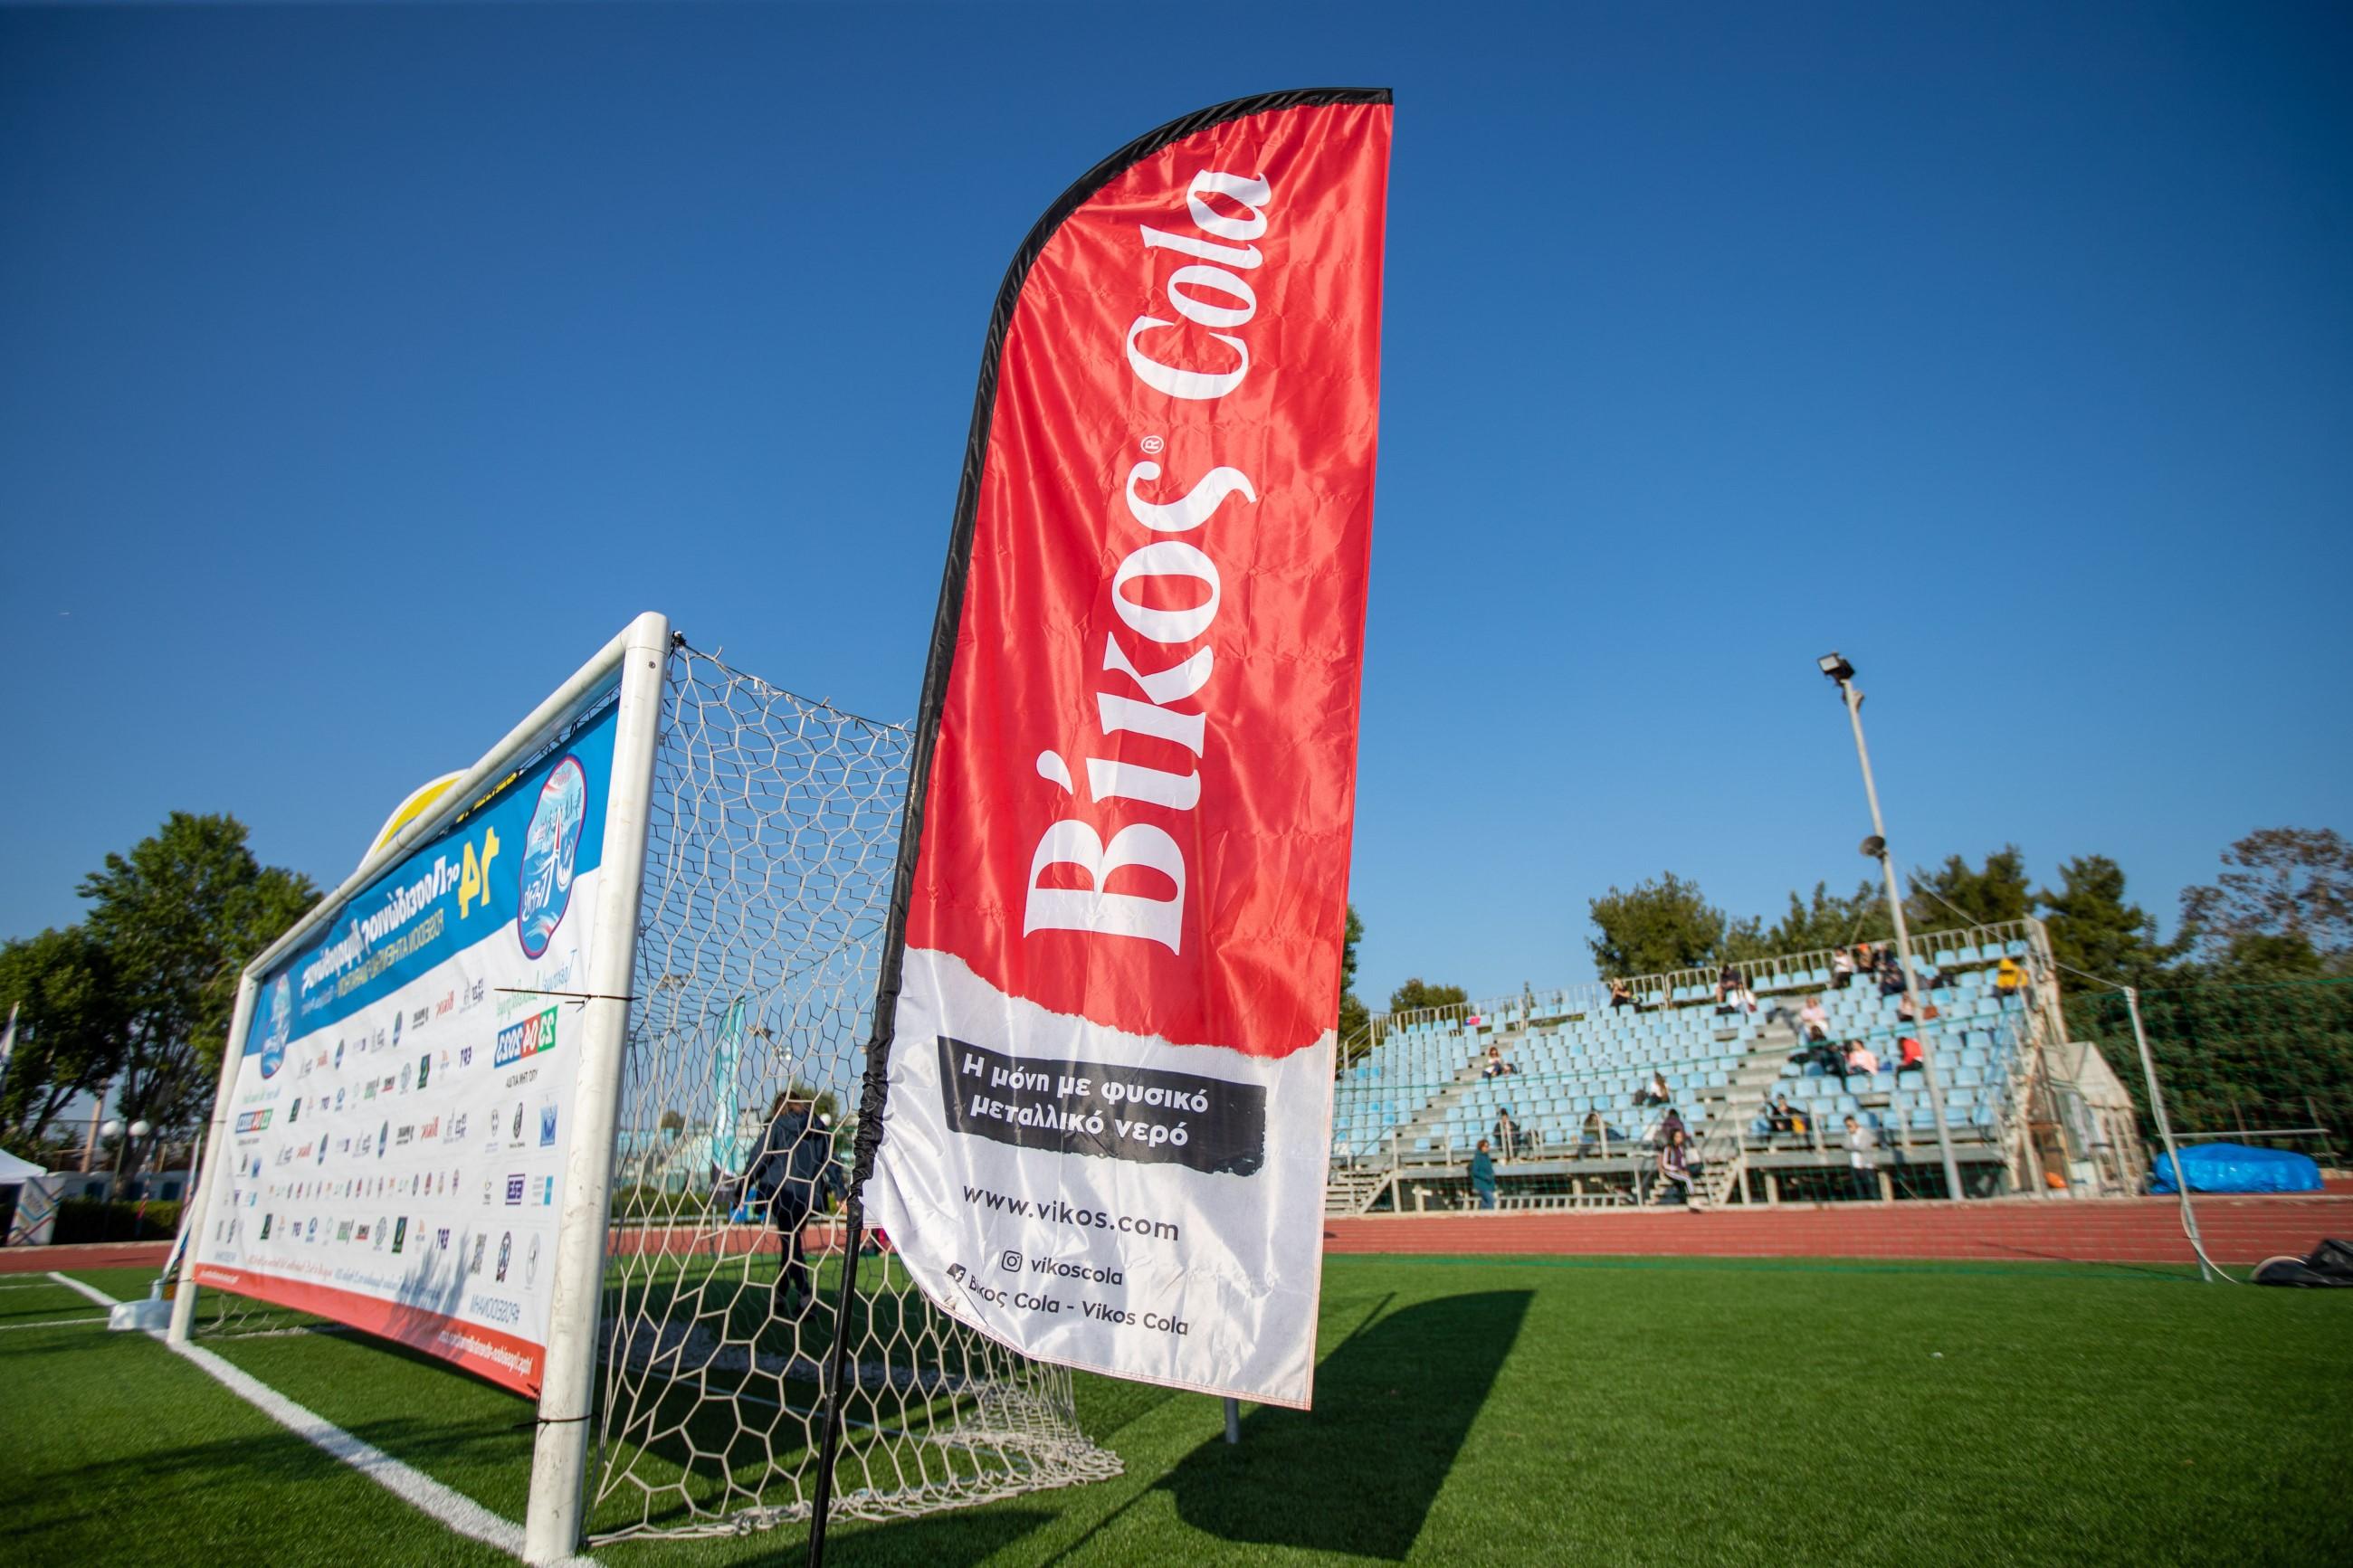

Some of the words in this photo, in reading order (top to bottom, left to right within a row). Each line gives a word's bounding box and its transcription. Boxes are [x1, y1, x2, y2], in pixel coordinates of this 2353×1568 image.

[1126, 168, 1272, 400] Cola
[962, 1052, 984, 1078] Η
[991, 1064, 1050, 1095] μόνη
[1057, 1074, 1091, 1099] με
[1100, 1080, 1209, 1114] φυσικό
[969, 1094, 1104, 1136] μεταλλικό
[1115, 1118, 1188, 1147] νερό
[963, 1183, 1180, 1242] www.vikos.com
[1030, 1256, 1123, 1286] vikoscola
[1014, 1291, 1061, 1314] Cola
[1081, 1300, 1136, 1326] Vikos
[1142, 1312, 1189, 1335] Cola
